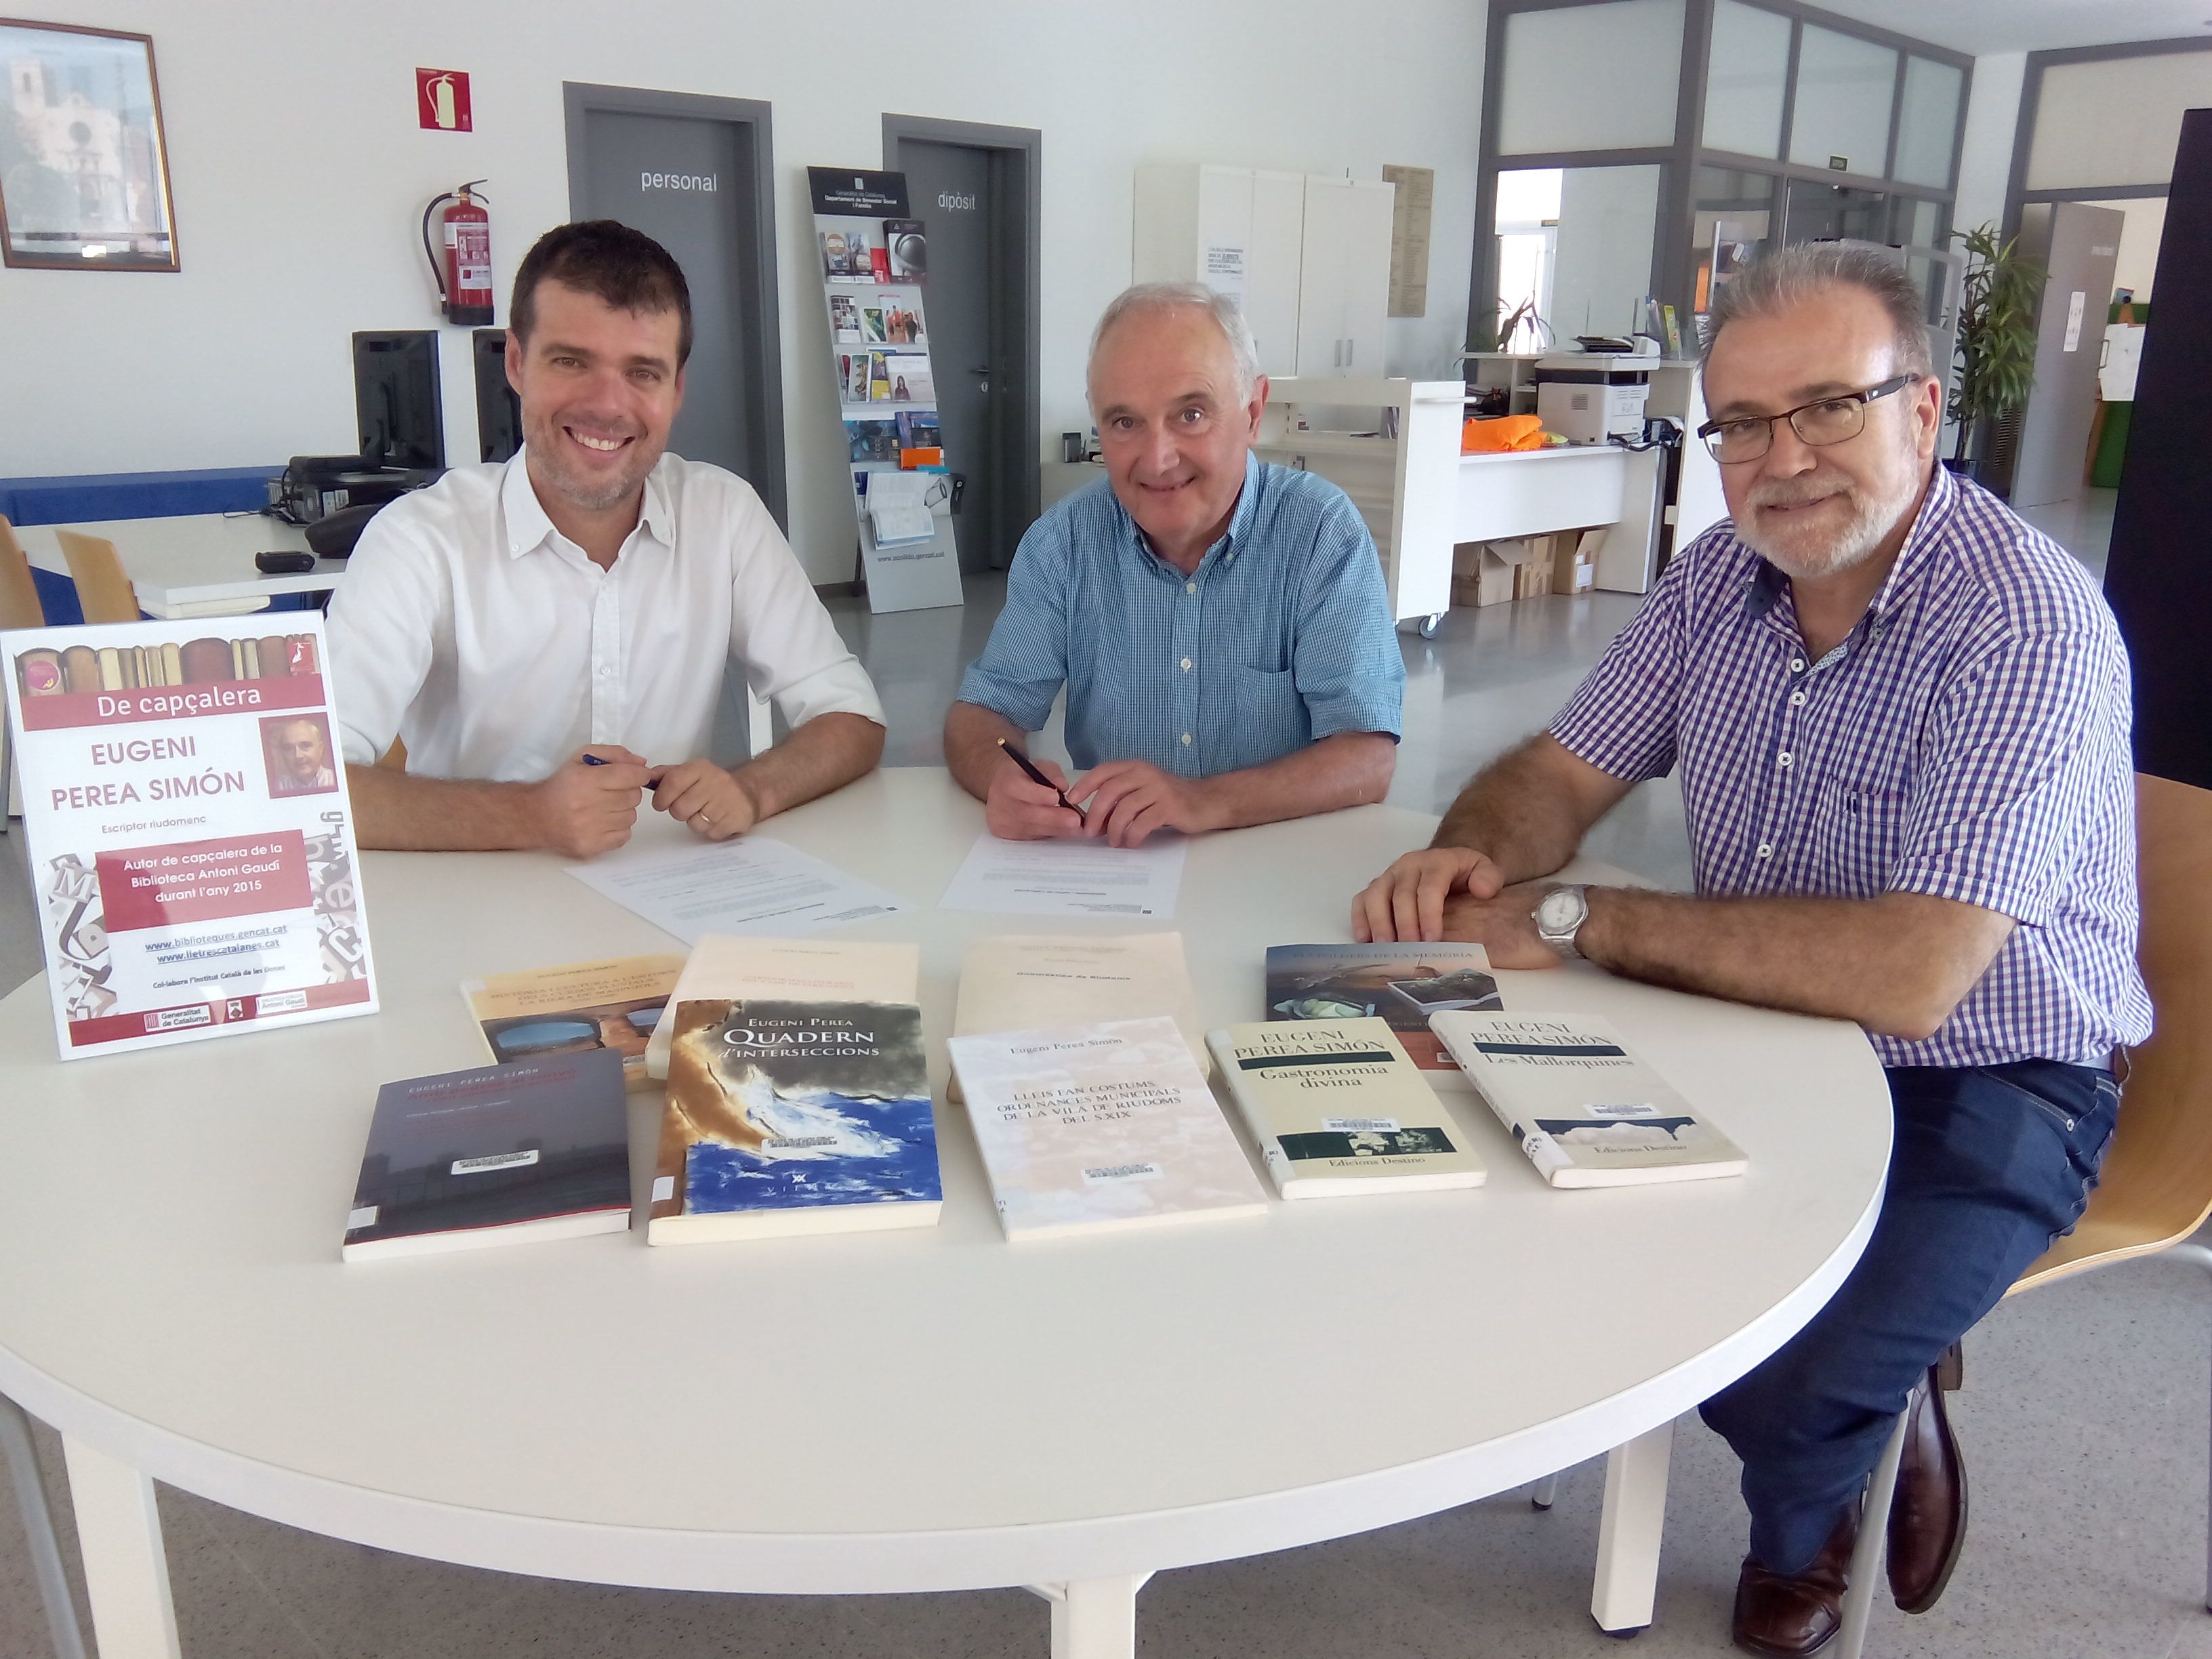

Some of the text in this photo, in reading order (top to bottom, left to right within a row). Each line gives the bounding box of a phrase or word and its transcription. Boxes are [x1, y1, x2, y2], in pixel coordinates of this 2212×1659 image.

[641, 171, 717, 192] personal
[938, 190, 976, 211] dipòsit
[98, 686, 261, 717] De capçalera
[91, 736, 196, 765] EUGENI
[52, 766, 245, 811] PEREA SIMÓN
[102, 815, 207, 834] Escriptor riudomenc
[123, 843, 282, 871] Autor de capçalera de la
[131, 859, 280, 888] Biblioteca Antoni Gaudí
[155, 880, 262, 903] durant l'any 2015
[145, 924, 287, 952] www.biblioteques.gencat.cat
[157, 939, 280, 964] www.lletrescatalanes.cat
[161, 1008, 201, 1019] Generalitat
[173, 1015, 209, 1026] Catalunya
[748, 1018, 854, 1027] EUGENI PEREA
[1490, 1021, 1572, 1033] EUGENI
[723, 1029, 874, 1048] QUADERN
[1010, 1038, 1122, 1054] Eugeni Perea Simón
[1261, 1030, 1345, 1044] EUGENI
[1470, 1032, 1541, 1044] PEREA
[718, 1048, 880, 1059] d'INTERSECCIONS
[1233, 1039, 1386, 1059] PEREA SIMÓN
[1485, 1054, 1634, 1069] Les Mallorquines
[409, 1082, 451, 1093] EUGENI
[460, 1075, 495, 1085] PEREA
[504, 1067, 539, 1078] SIMÓN
[1260, 1064, 1389, 1080] Gastronomia
[1014, 1080, 1155, 1101] LLEIS FAN COSTUMS
[1300, 1076, 1362, 1088] divina
[997, 1086, 1181, 1113] ORDENANCES MUNICIPALS
[1004, 1113, 1019, 1121] DE
[1027, 1110, 1047, 1118] LA
[1052, 1106, 1087, 1115] VILA
[1115, 1097, 1182, 1110] RIUDOMS
[1062, 1115, 1090, 1125] DEL
[1593, 1145, 1642, 1153] Edicions
[1329, 1157, 1426, 1167] Edicions Destino
